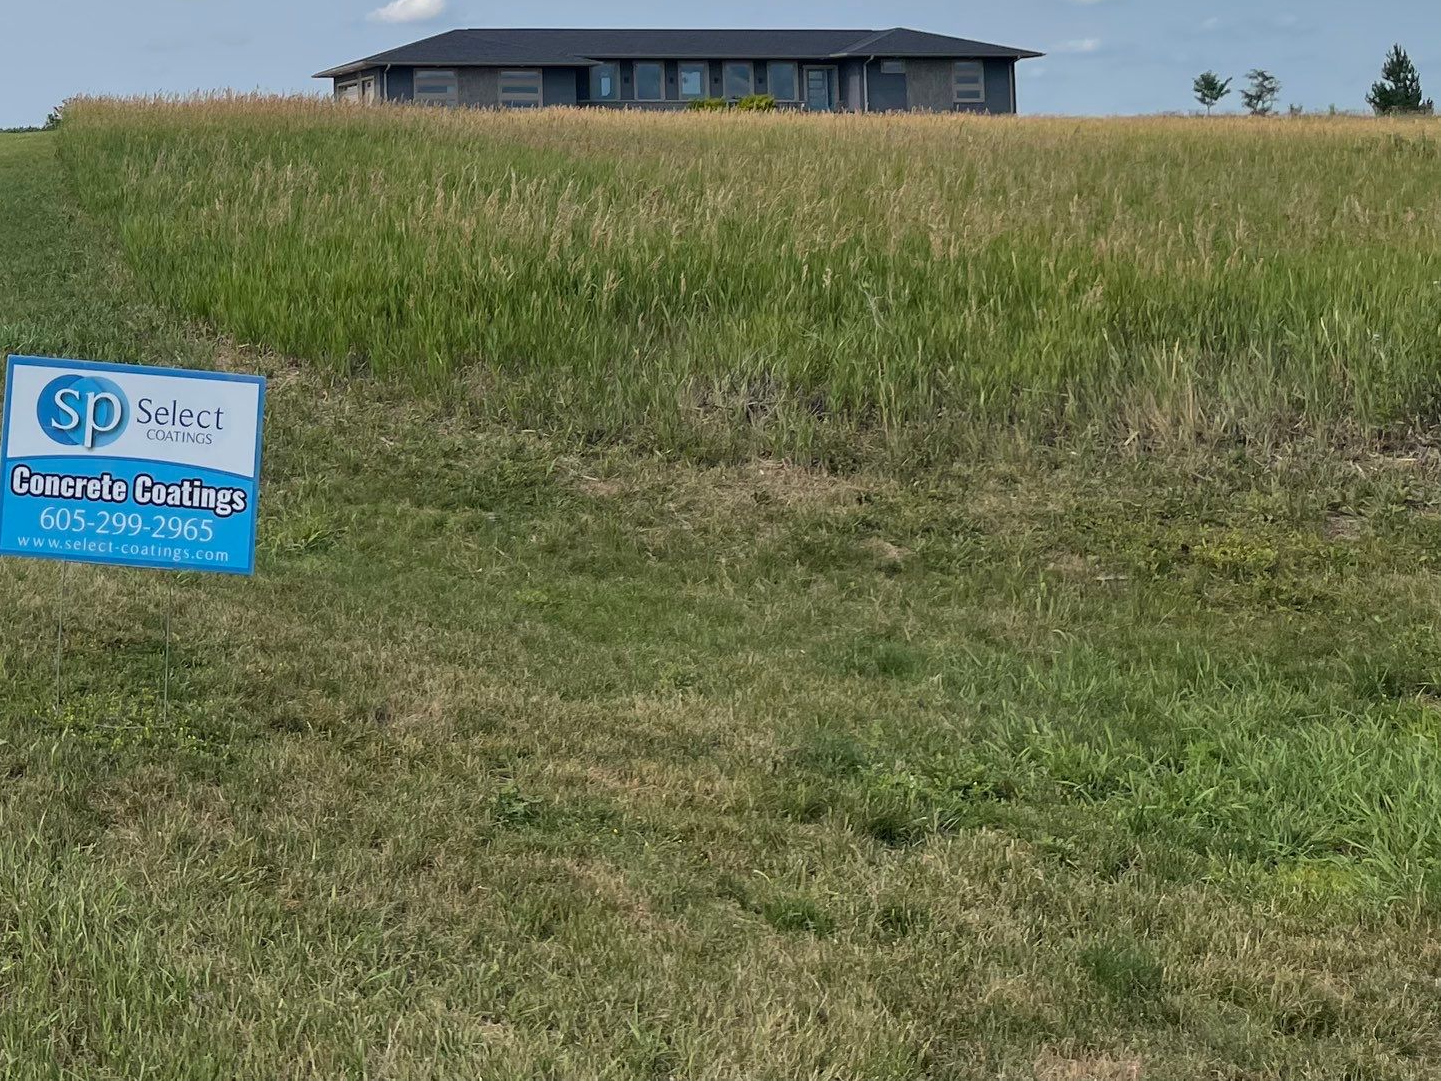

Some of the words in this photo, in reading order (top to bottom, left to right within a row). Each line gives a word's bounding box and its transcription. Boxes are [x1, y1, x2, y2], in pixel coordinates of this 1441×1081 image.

[51, 388, 122, 448] sp
[136, 398, 224, 431] Select
[147, 428, 213, 445] COATINGS
[11, 464, 128, 503] Concrete
[133, 473, 247, 517] Coatings
[40, 507, 214, 542] 605-299-2965
[18, 536, 229, 562] www.select-coatings.com
